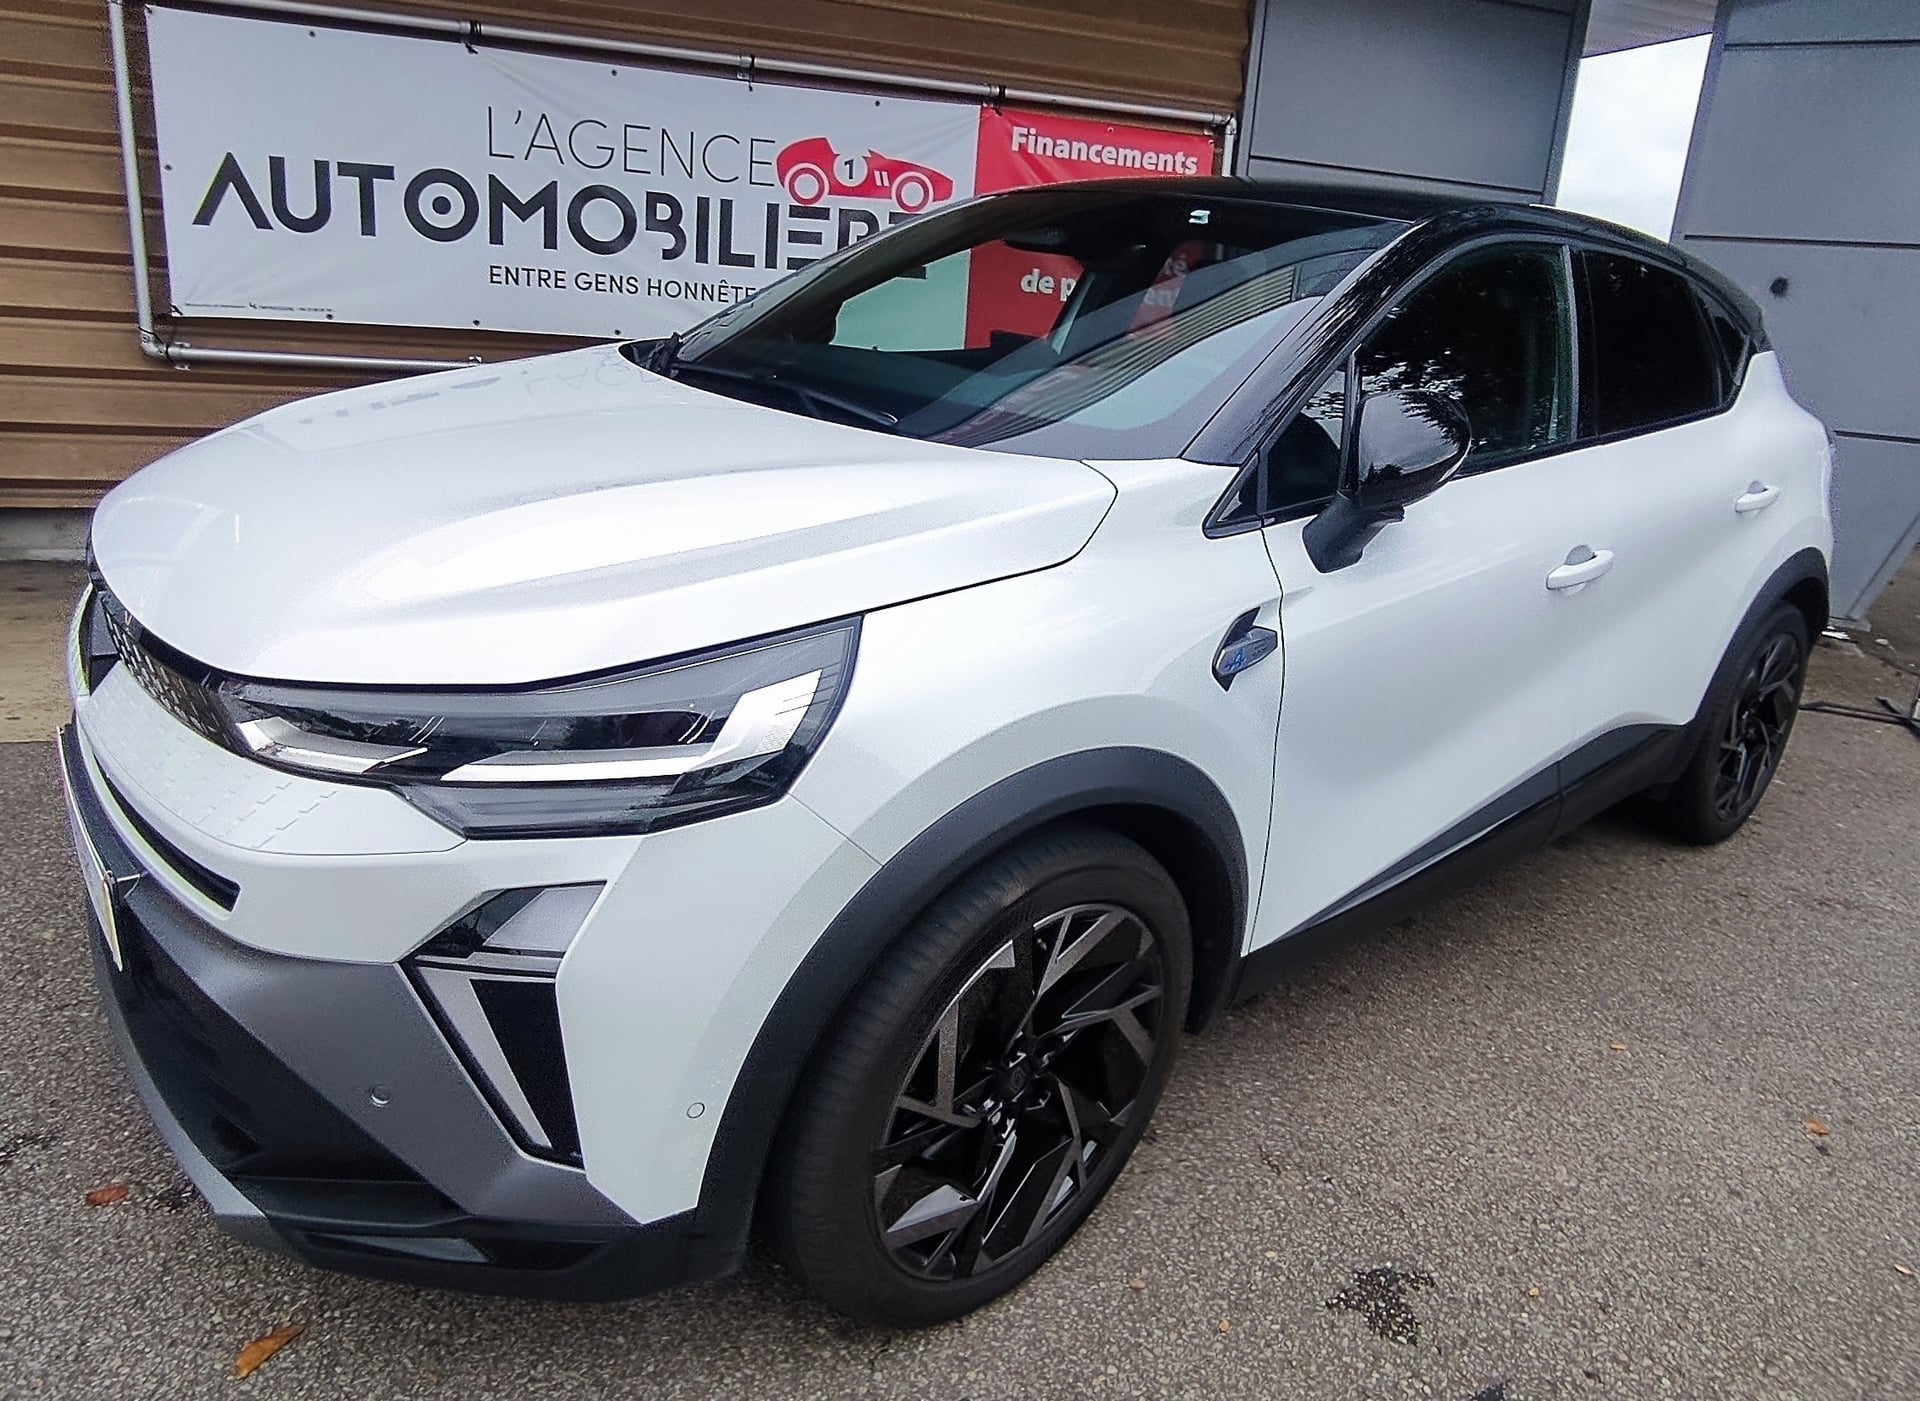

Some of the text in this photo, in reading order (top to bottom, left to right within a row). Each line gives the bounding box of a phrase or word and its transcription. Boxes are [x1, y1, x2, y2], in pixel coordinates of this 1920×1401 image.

[487, 105, 777, 187] L'AGENCE
[1011, 125, 1198, 176] Financements
[844, 158, 854, 180] 1
[489, 265, 567, 290] ENTRE
[574, 271, 639, 296] GENS
[1020, 267, 1055, 294] de
